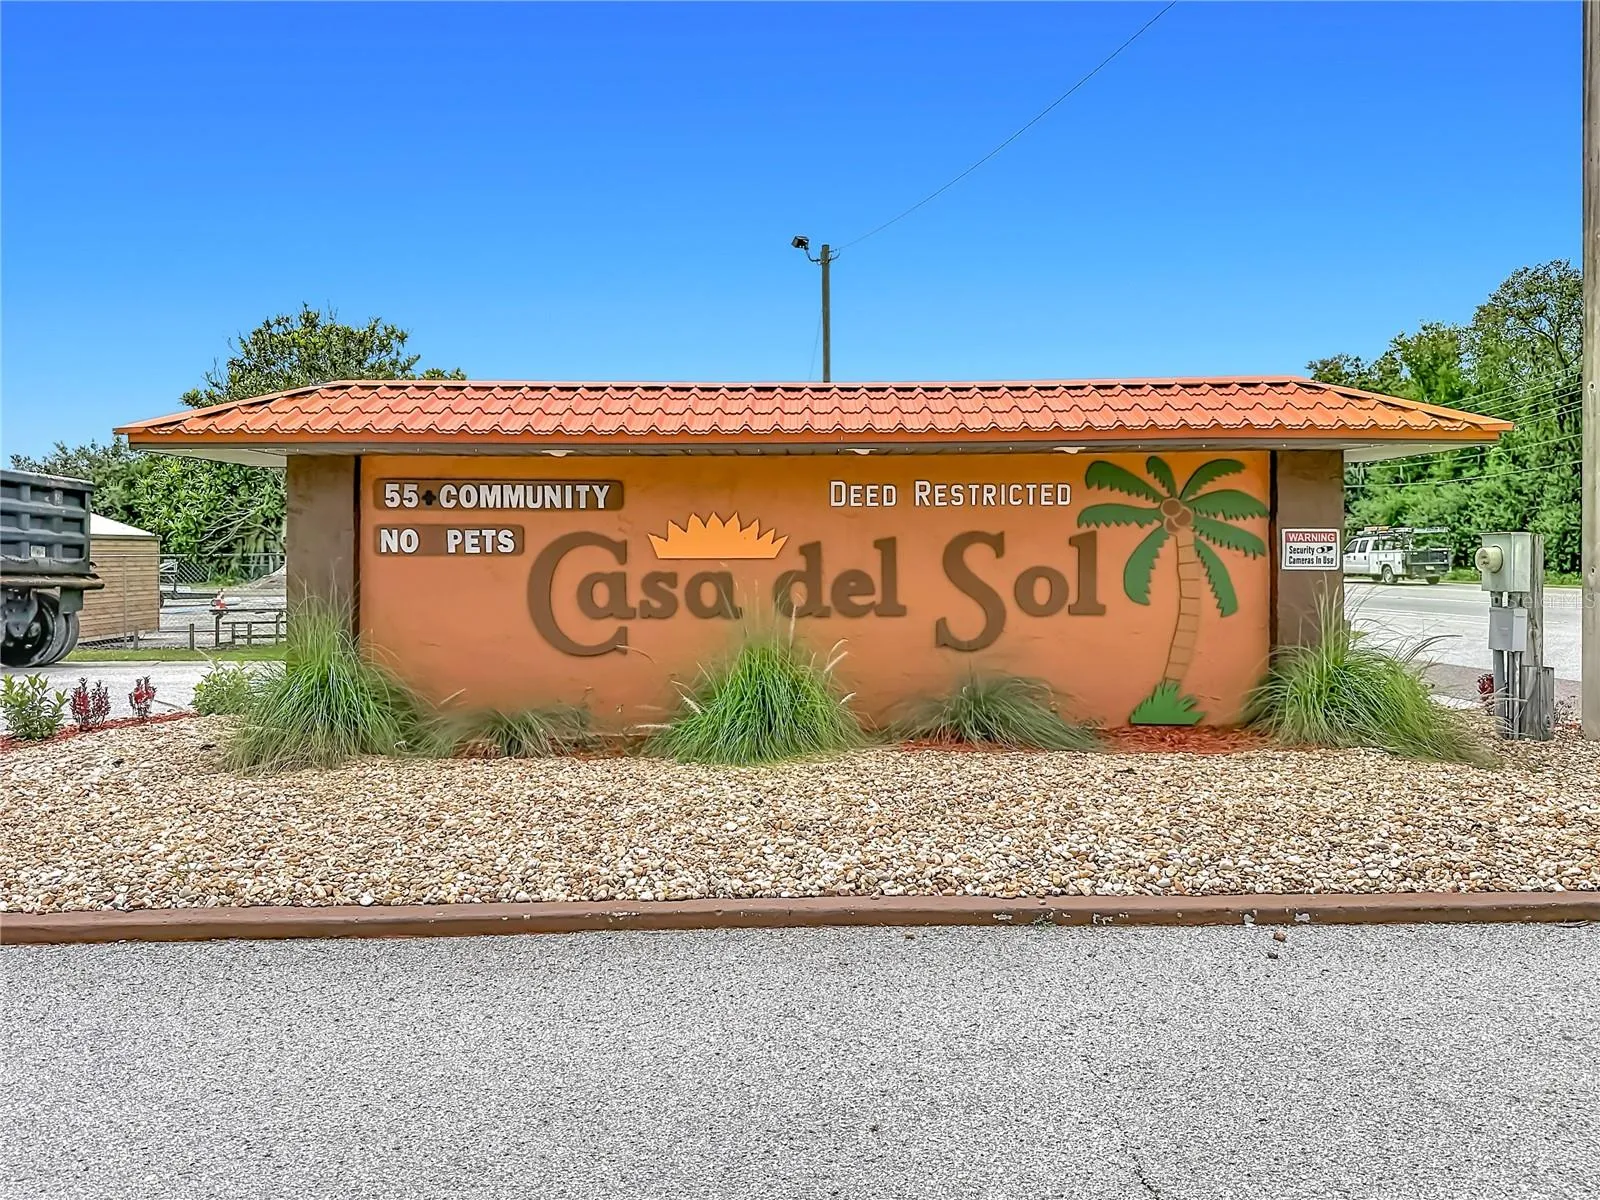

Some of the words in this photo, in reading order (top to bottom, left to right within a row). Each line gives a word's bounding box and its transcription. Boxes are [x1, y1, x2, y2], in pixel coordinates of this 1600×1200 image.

[380, 528, 419, 553] NO
[447, 528, 516, 553] PETS
[1288, 533, 1335, 541] WARNING
[1288, 545, 1315, 556] Security
[1288, 556, 1315, 565] Cameras
[527, 531, 743, 657] Casa
[772, 536, 907, 618] del
[935, 530, 1106, 652] Sol
